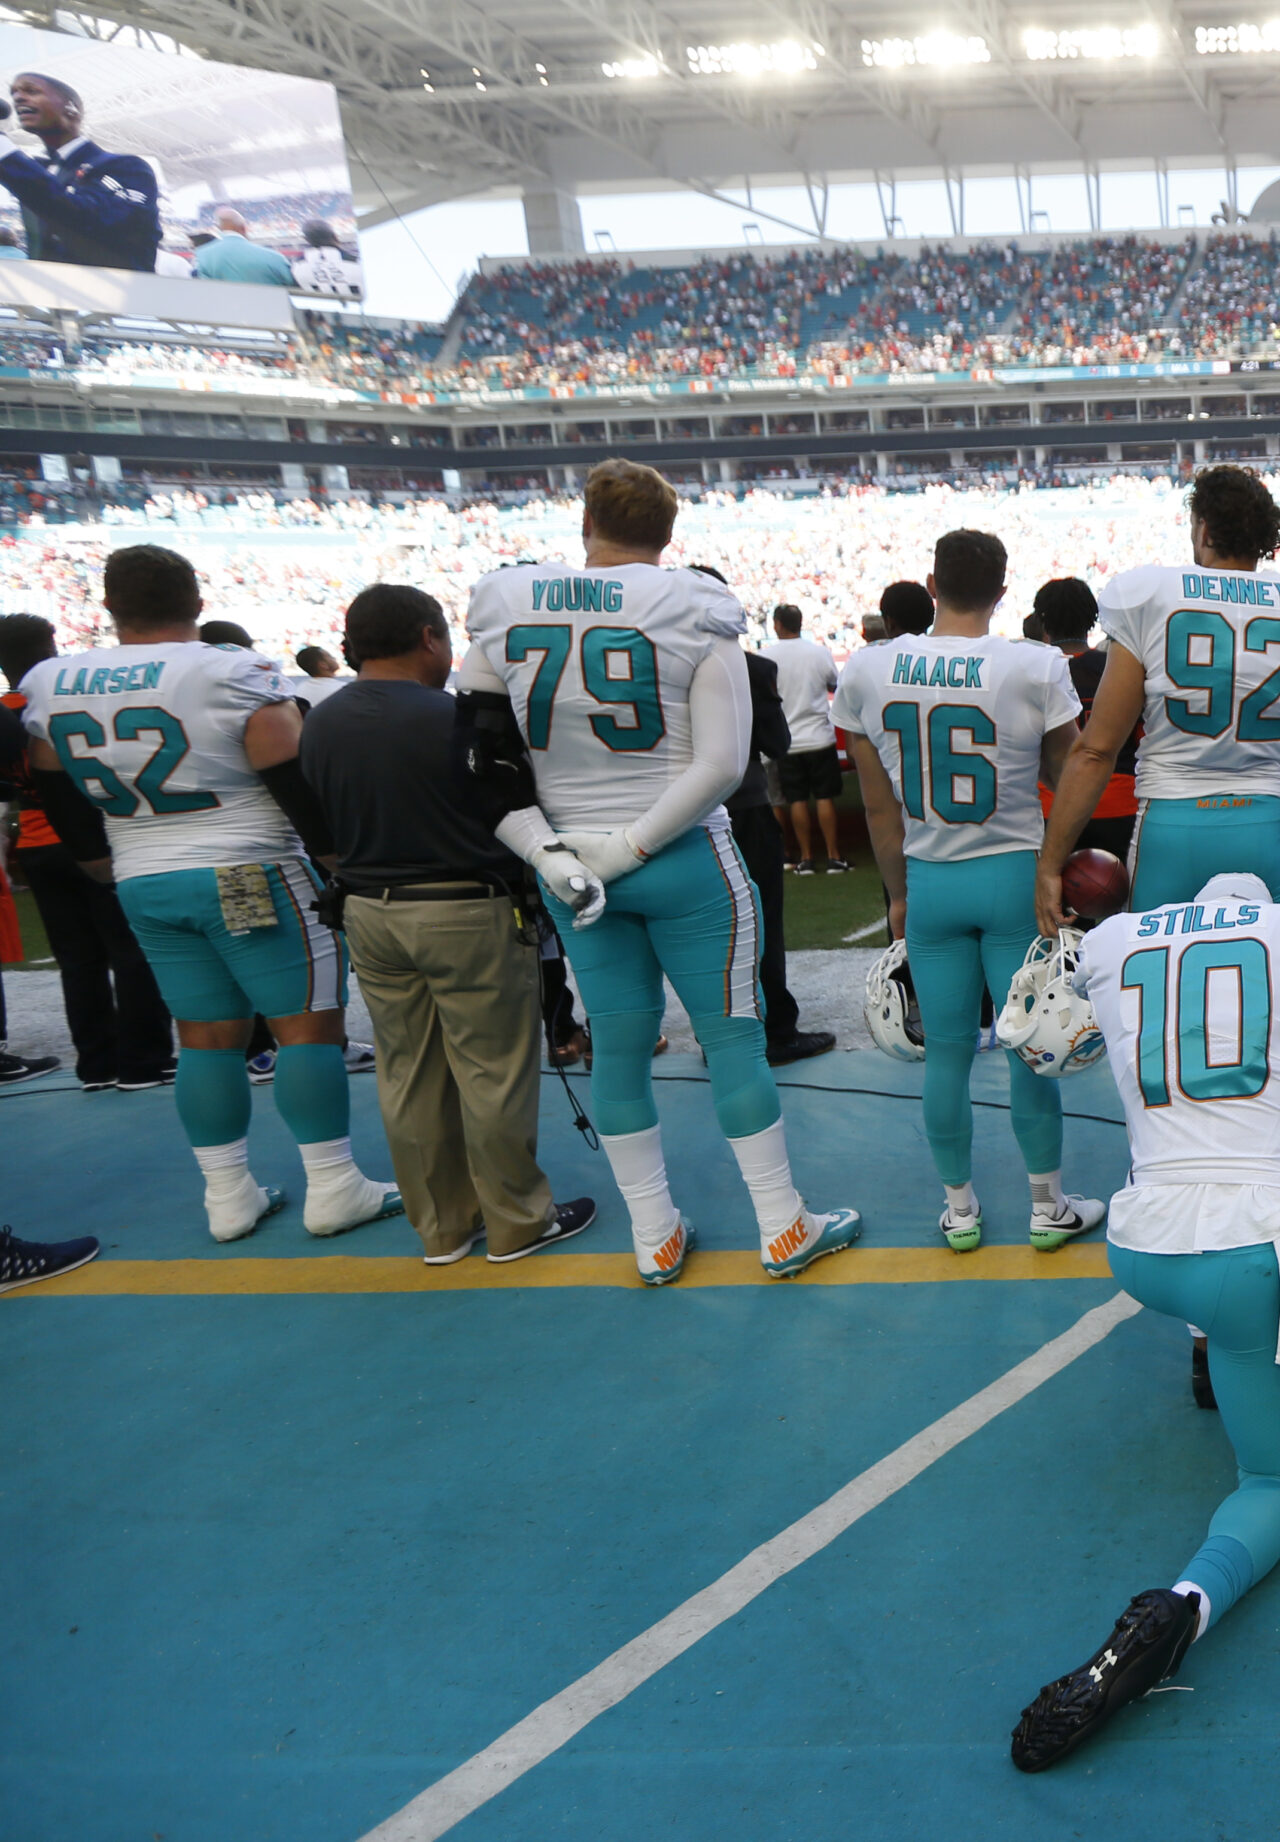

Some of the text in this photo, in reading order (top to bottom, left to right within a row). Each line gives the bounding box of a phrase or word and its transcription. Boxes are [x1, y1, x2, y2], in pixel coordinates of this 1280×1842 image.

[1240, 361, 1259, 370] 4:21
[532, 577, 623, 612] YOUNG
[54, 661, 165, 696] LARSEN
[506, 624, 667, 752] 79
[892, 653, 984, 688] HAACK
[48, 706, 222, 817] 62
[882, 701, 997, 825] 16
[1196, 797, 1253, 809] MIAMI
[1137, 905, 1261, 937] STILLS
[1120, 936, 1273, 1109] 10
[653, 1223, 684, 1271] NIKE
[768, 1215, 808, 1264] NIKE
